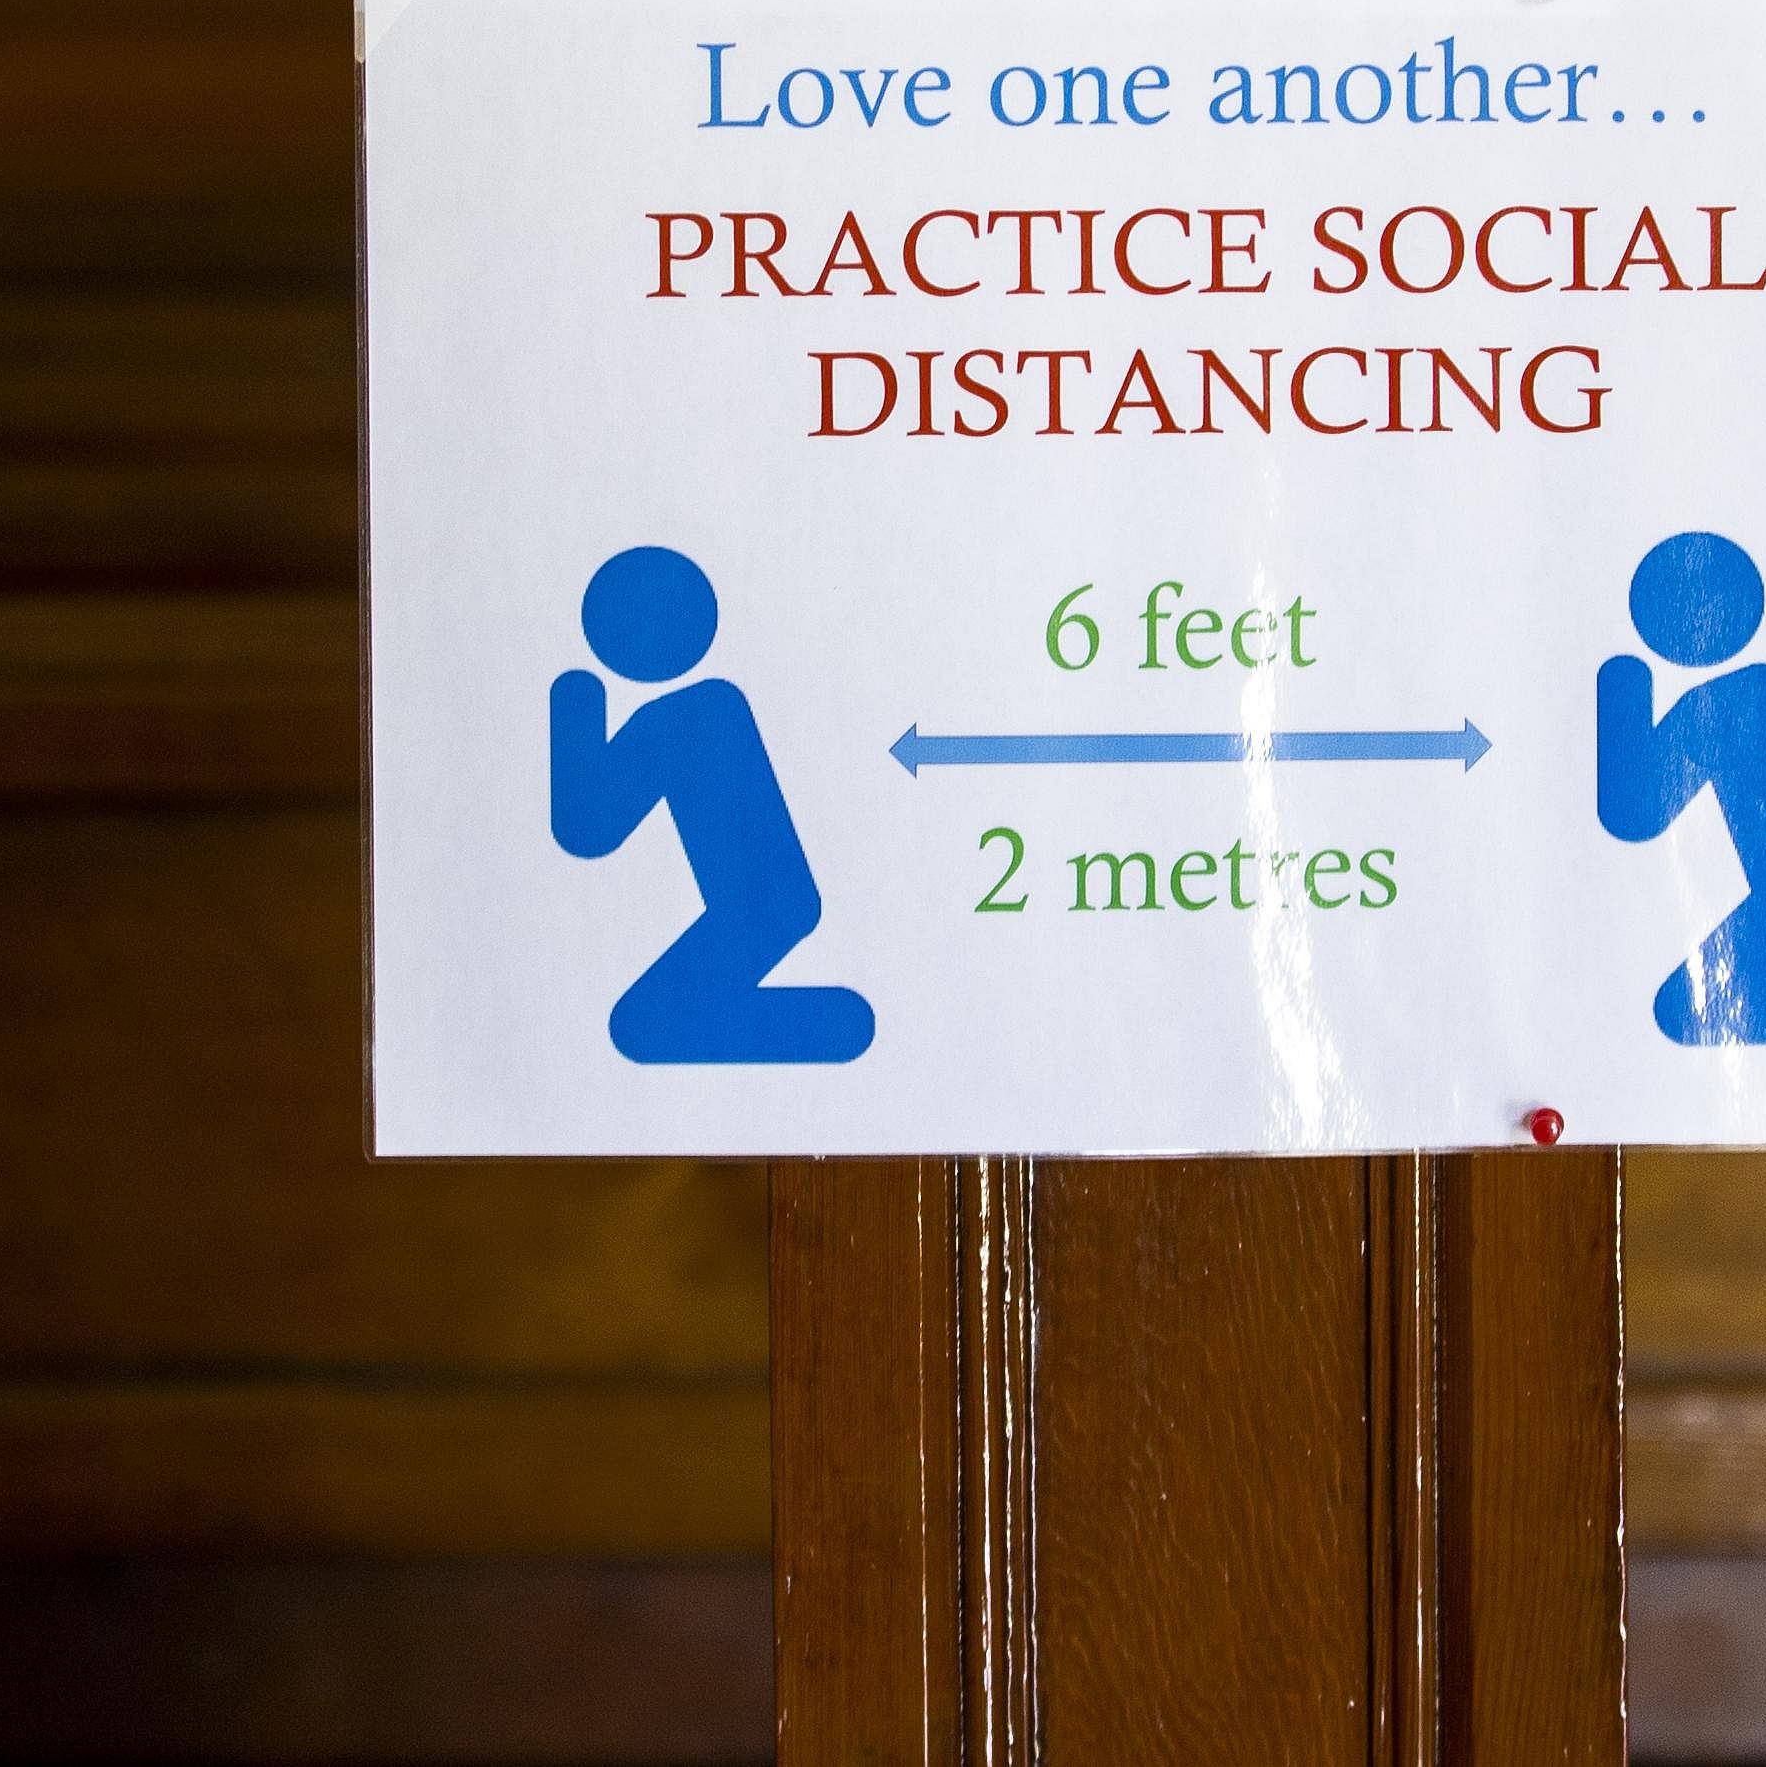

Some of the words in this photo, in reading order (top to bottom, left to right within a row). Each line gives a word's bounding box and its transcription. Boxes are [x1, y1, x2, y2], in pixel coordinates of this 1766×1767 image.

[697, 42, 953, 130] Love
[988, 64, 1172, 128] one
[646, 208, 1272, 298] PRACTICE
[807, 345, 1611, 438] DISTANCING
[1045, 583, 1100, 671] 6
[1138, 580, 1317, 670] feet
[974, 825, 1029, 913] 2
